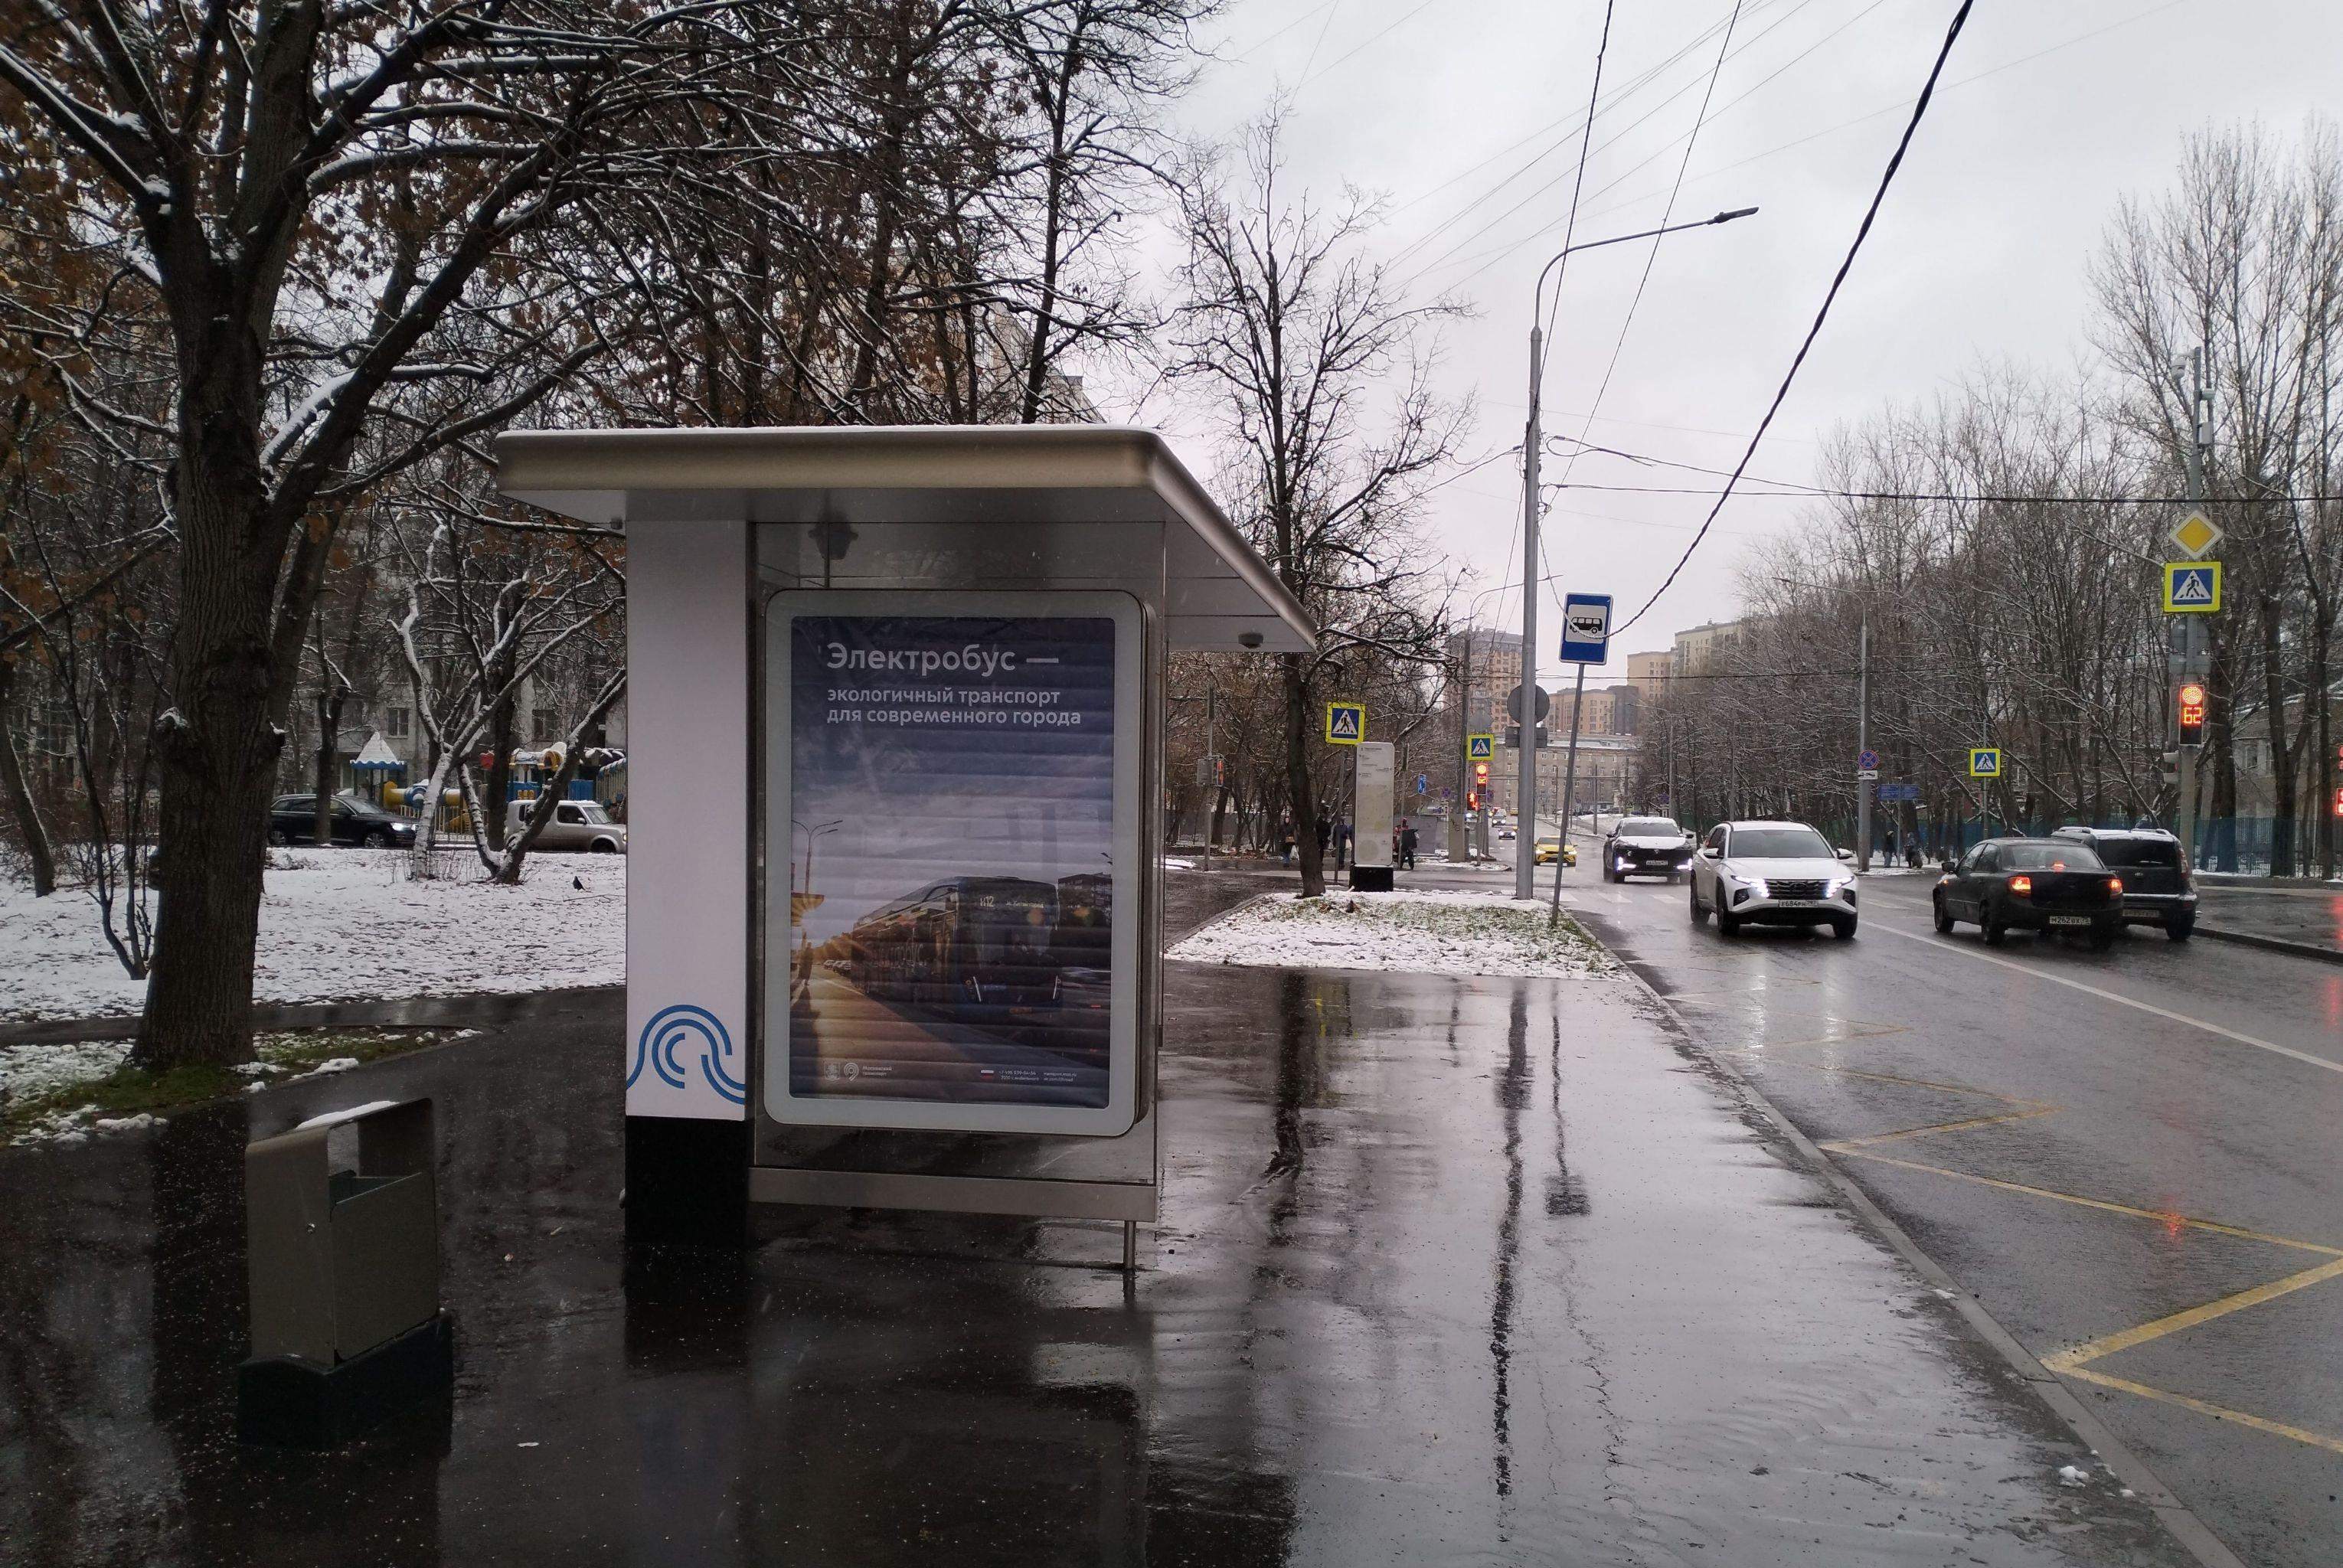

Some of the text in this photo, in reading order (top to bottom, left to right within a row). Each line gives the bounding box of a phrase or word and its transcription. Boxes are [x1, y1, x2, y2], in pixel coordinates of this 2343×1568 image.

[827, 642, 1016, 678] Электробус
[827, 687, 1060, 707] экологичный транспорт
[827, 709, 1081, 727] для современного города
